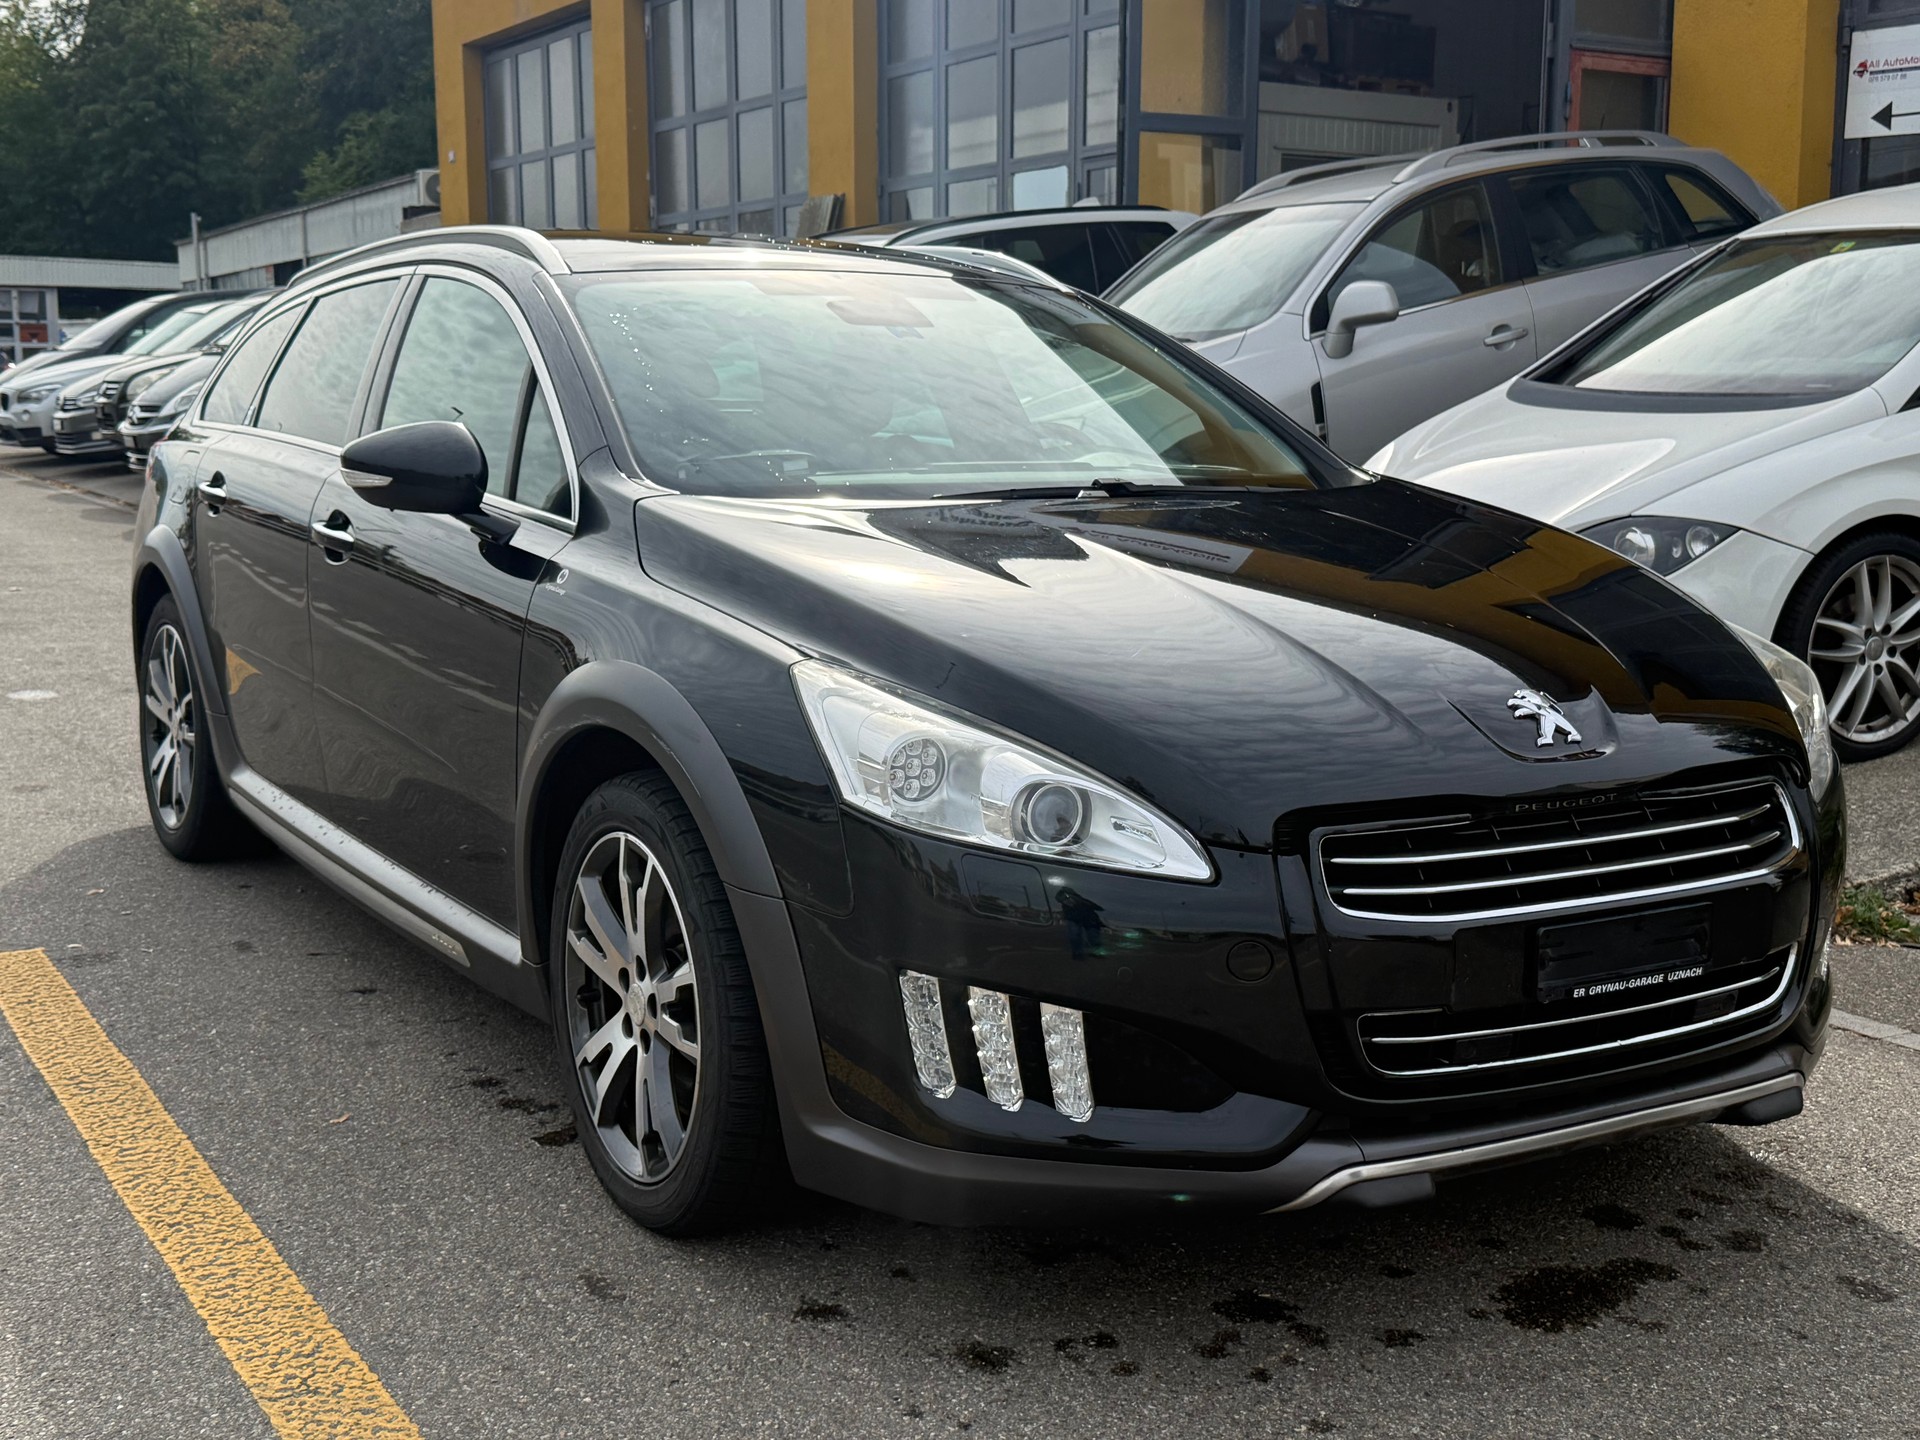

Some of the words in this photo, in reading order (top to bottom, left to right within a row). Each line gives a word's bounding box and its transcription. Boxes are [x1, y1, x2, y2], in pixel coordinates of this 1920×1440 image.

[1869, 59, 1880, 68] All
[1515, 793, 1617, 812] PEUGEOT
[1573, 988, 1586, 998] ER
[1589, 974, 1665, 995] GRYNAU-GARAGE
[1667, 967, 1703, 981] UZNACH
